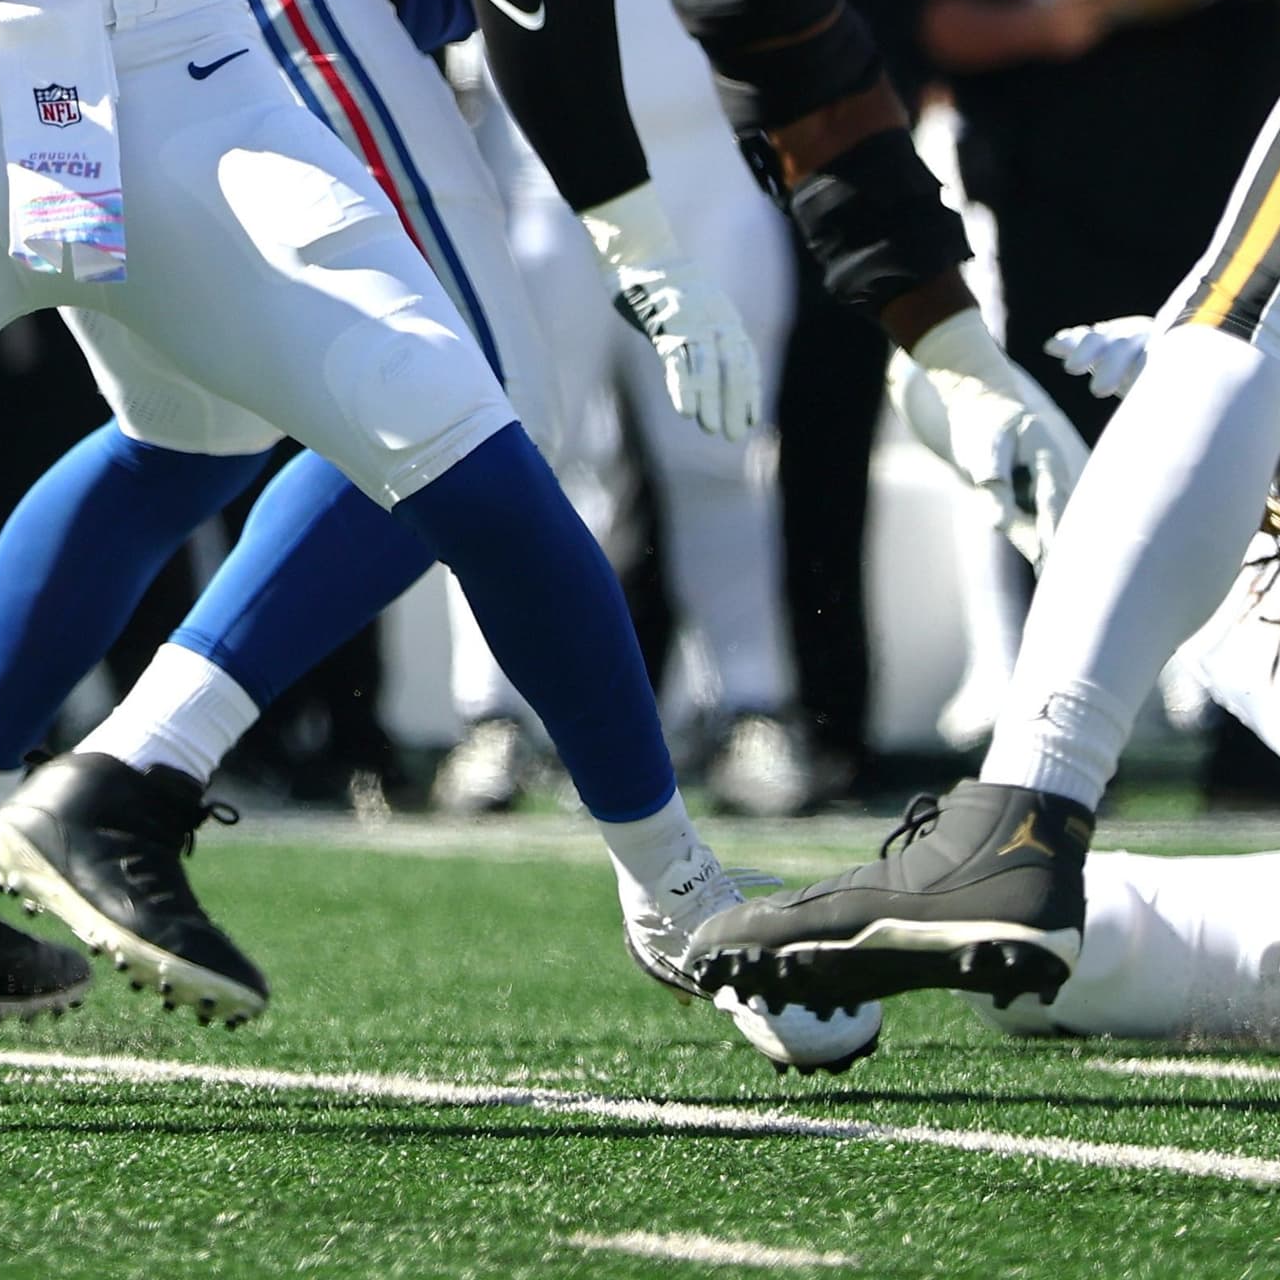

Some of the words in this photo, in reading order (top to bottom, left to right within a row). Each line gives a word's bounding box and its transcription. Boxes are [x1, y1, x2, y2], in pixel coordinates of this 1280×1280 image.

[41, 102, 78, 123] NFL
[29, 151, 89, 161] CRUCIAL
[18, 159, 102, 179] CATCH
